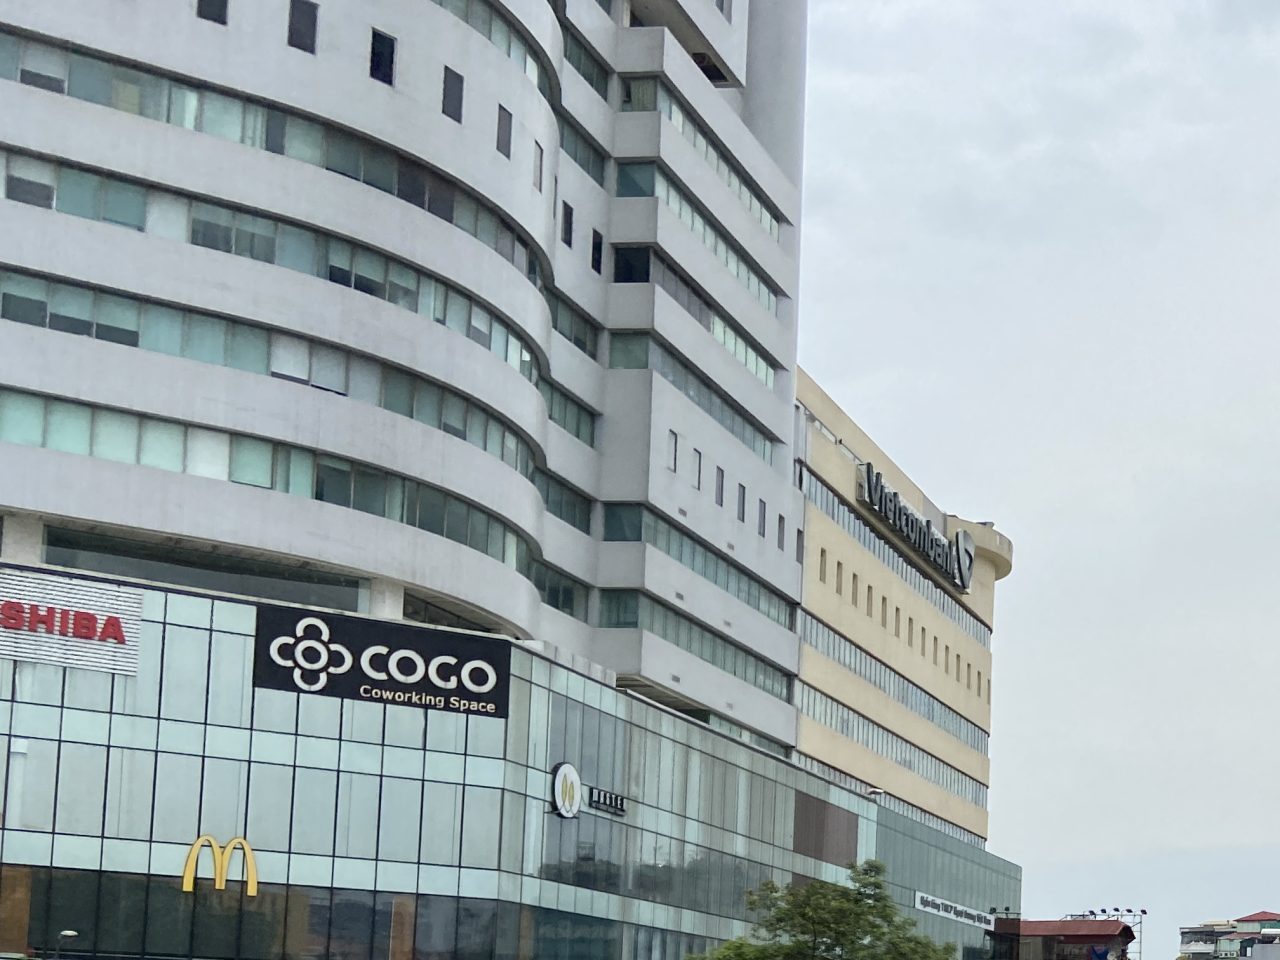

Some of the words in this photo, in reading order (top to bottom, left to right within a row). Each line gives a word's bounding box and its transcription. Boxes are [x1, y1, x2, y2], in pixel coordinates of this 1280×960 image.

[867, 462, 956, 581] Vietcombank
[0, 600, 126, 645] SHIBA
[360, 645, 497, 693] COGO
[360, 685, 445, 708] Coworking
[449, 696, 496, 713] Space
